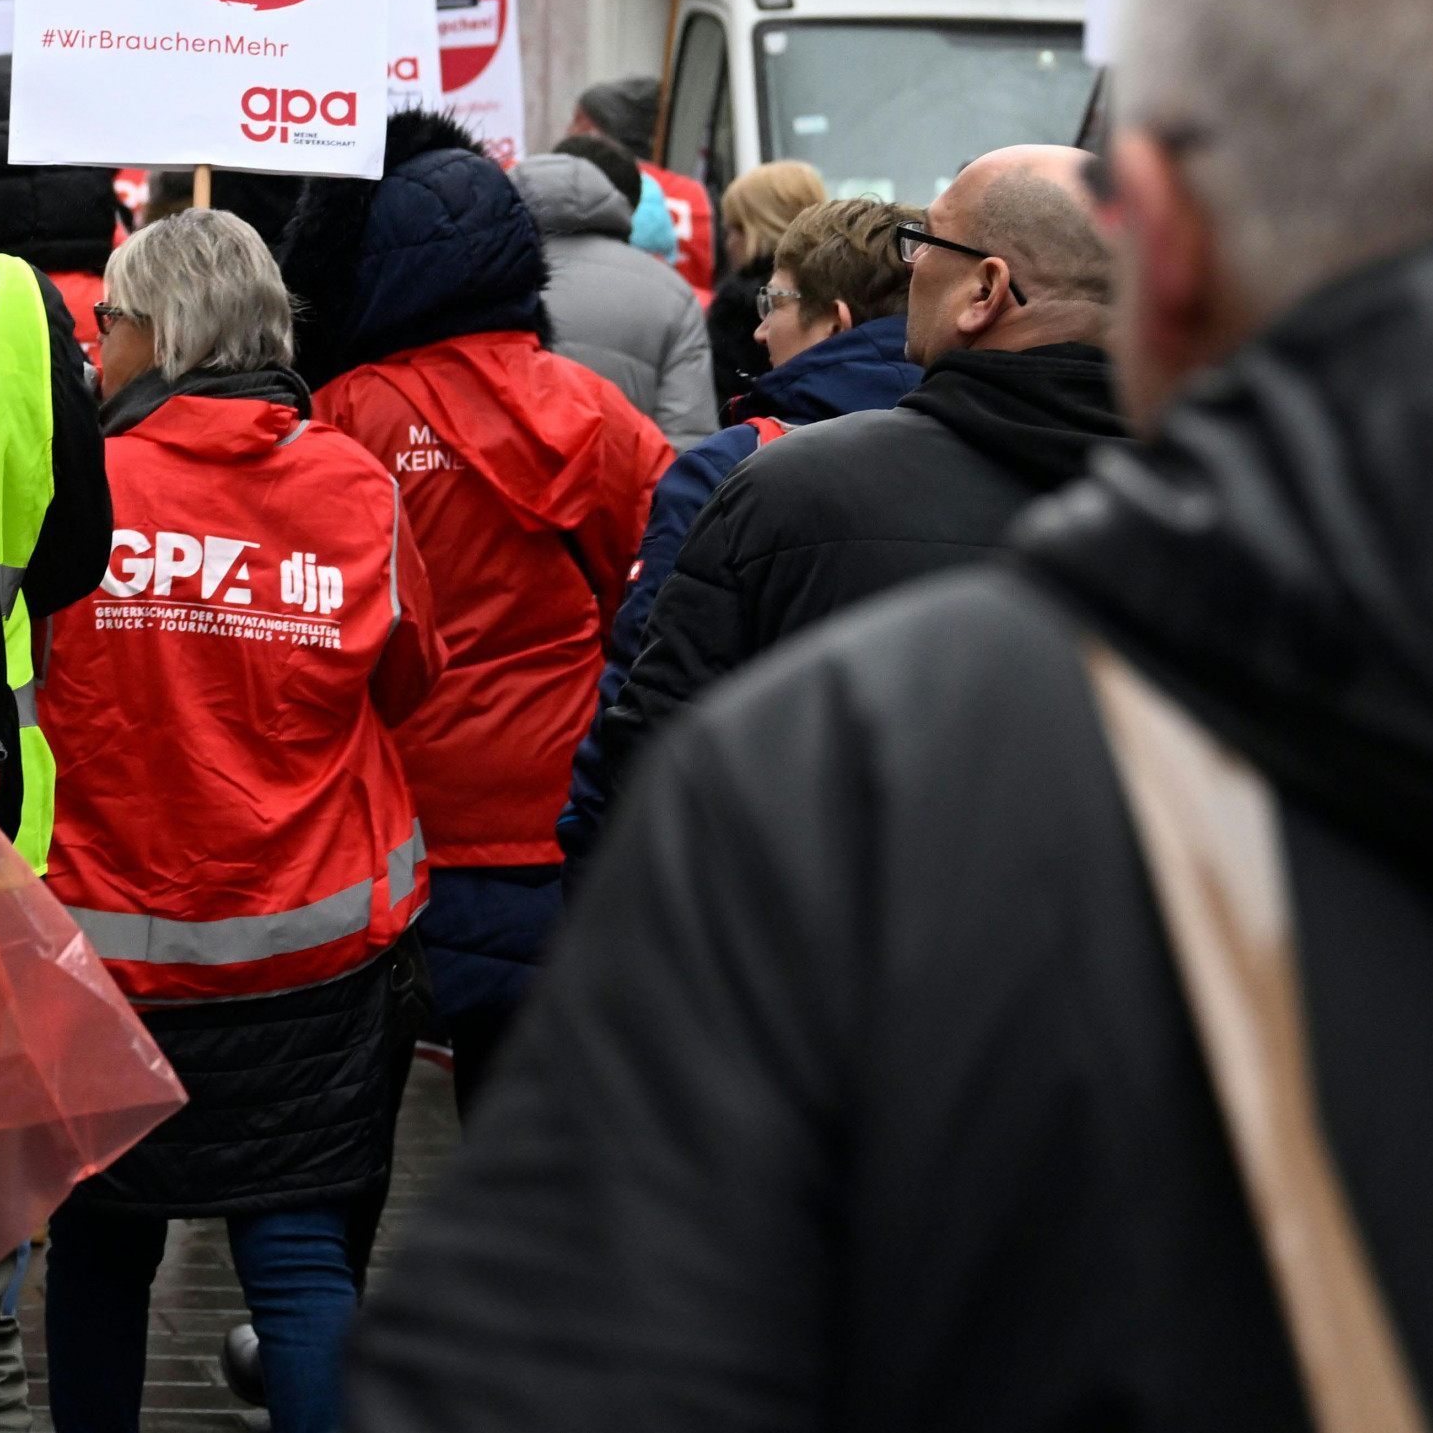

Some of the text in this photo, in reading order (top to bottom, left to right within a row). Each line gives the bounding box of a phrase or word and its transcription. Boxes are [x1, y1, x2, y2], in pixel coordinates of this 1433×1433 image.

[41, 28, 290, 58] #WirBrauchenMehr
[240, 85, 357, 144] gpa
[293, 138, 356, 147] GEWERKSCHAFT
[280, 550, 344, 615] djp
[95, 605, 341, 638] GEWERKSCHAFT DER PRIVATANGESTELLTEN
[159, 619, 273, 642] JOURNALISMUS
[291, 634, 342, 650] PAPIER
